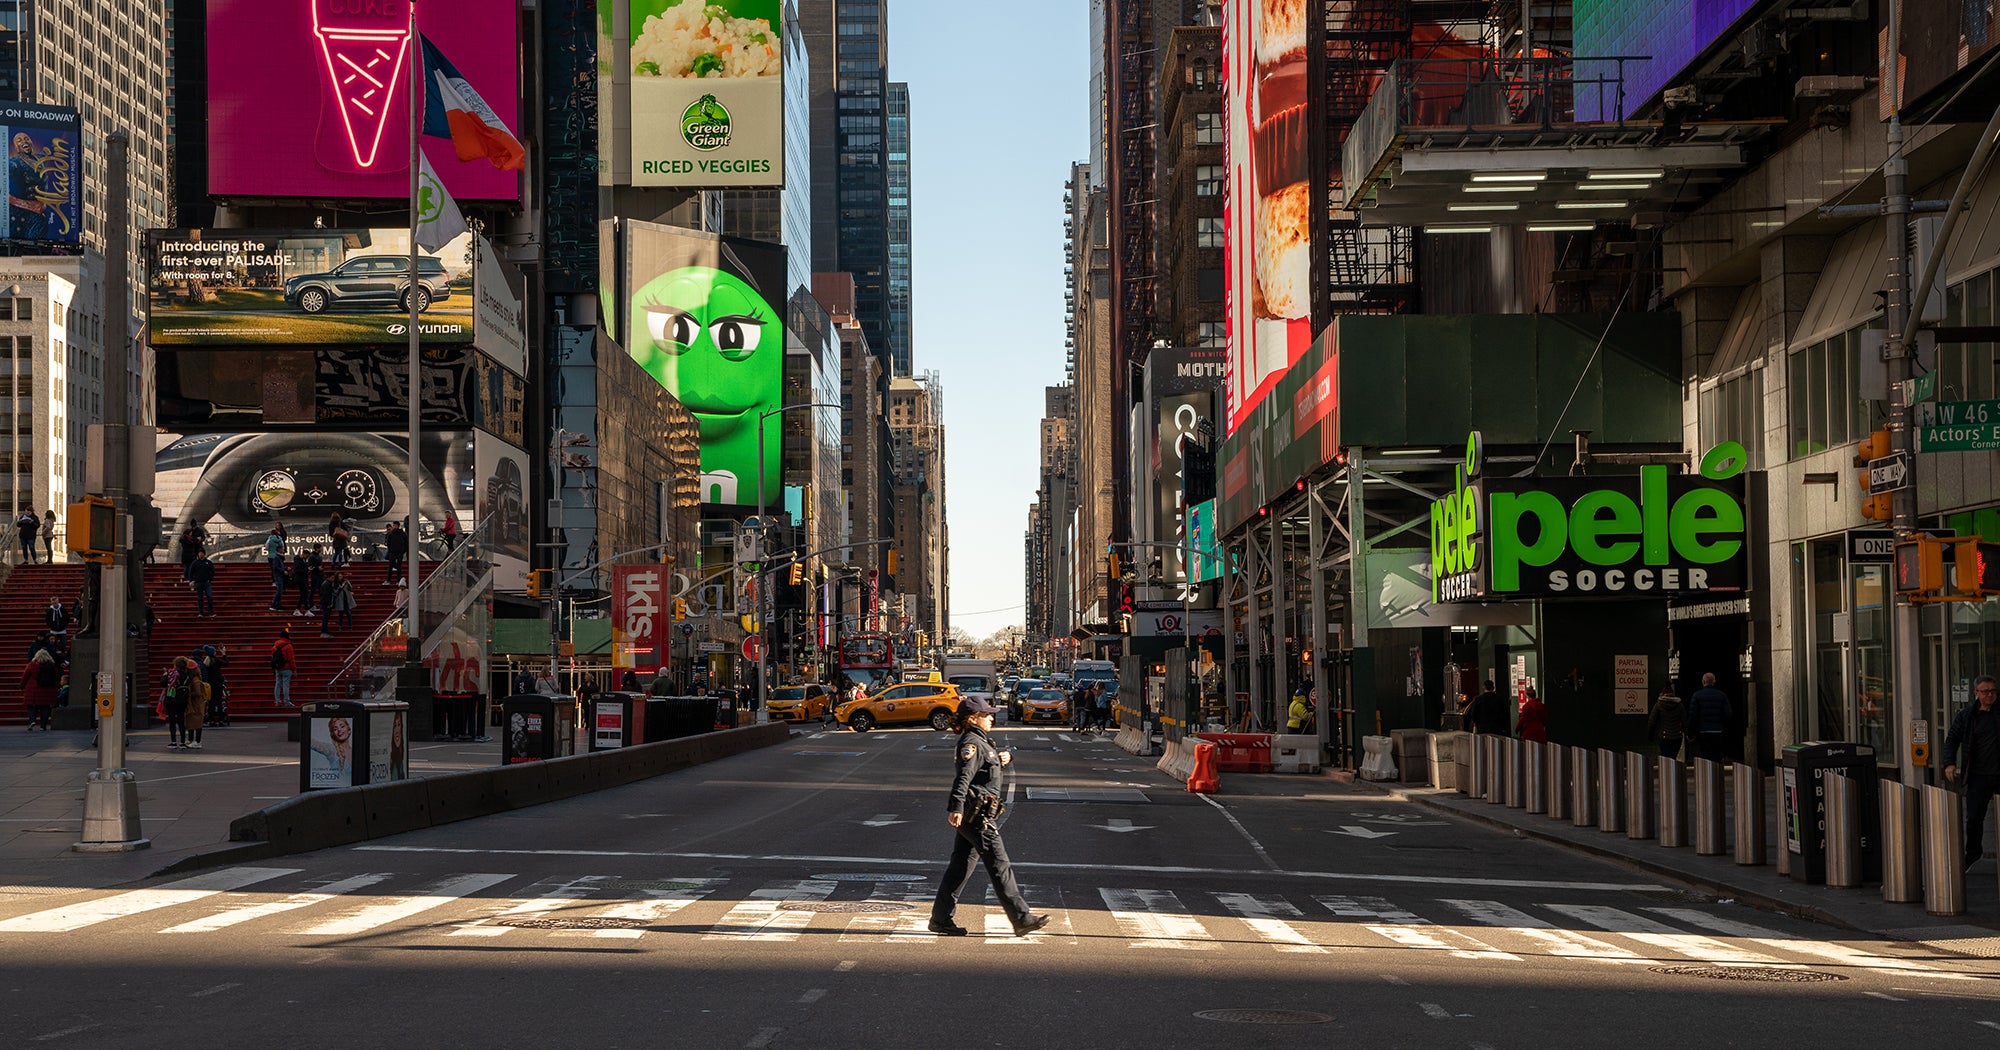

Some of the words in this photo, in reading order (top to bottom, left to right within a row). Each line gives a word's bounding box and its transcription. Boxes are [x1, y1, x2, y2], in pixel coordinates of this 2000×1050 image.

[5, 109, 21, 118] ON
[24, 110, 75, 122] BROADWAY
[687, 122, 730, 135] Green
[692, 133, 732, 147] Giant
[642, 160, 693, 174] RICED
[698, 159, 771, 173] VEGGIES
[34, 137, 70, 235] Aladdin
[162, 240, 240, 254] Introducing
[242, 240, 265, 252] the
[162, 254, 224, 266] first-ever
[226, 254, 296, 266] PALISADE.
[162, 271, 184, 280] With
[185, 271, 210, 280] room
[211, 271, 225, 280] for
[226, 271, 235, 280] 8.
[409, 324, 462, 334] YUNDAI
[1938, 405, 1955, 425] W
[1964, 403, 1989, 424] 46
[1929, 426, 1985, 443] Actors'
[1872, 468, 1885, 484] ONE
[1490, 440, 1748, 592] pelé
[1034, 520, 1042, 584] WELLINGTON
[1863, 540, 1894, 553] ONE
[1441, 573, 1471, 601] SOCCER
[1548, 568, 1709, 591] SOCCER
[626, 570, 660, 639] tkts
[1715, 600, 1734, 617] SOCCER
[312, 771, 340, 781] FROZEN
